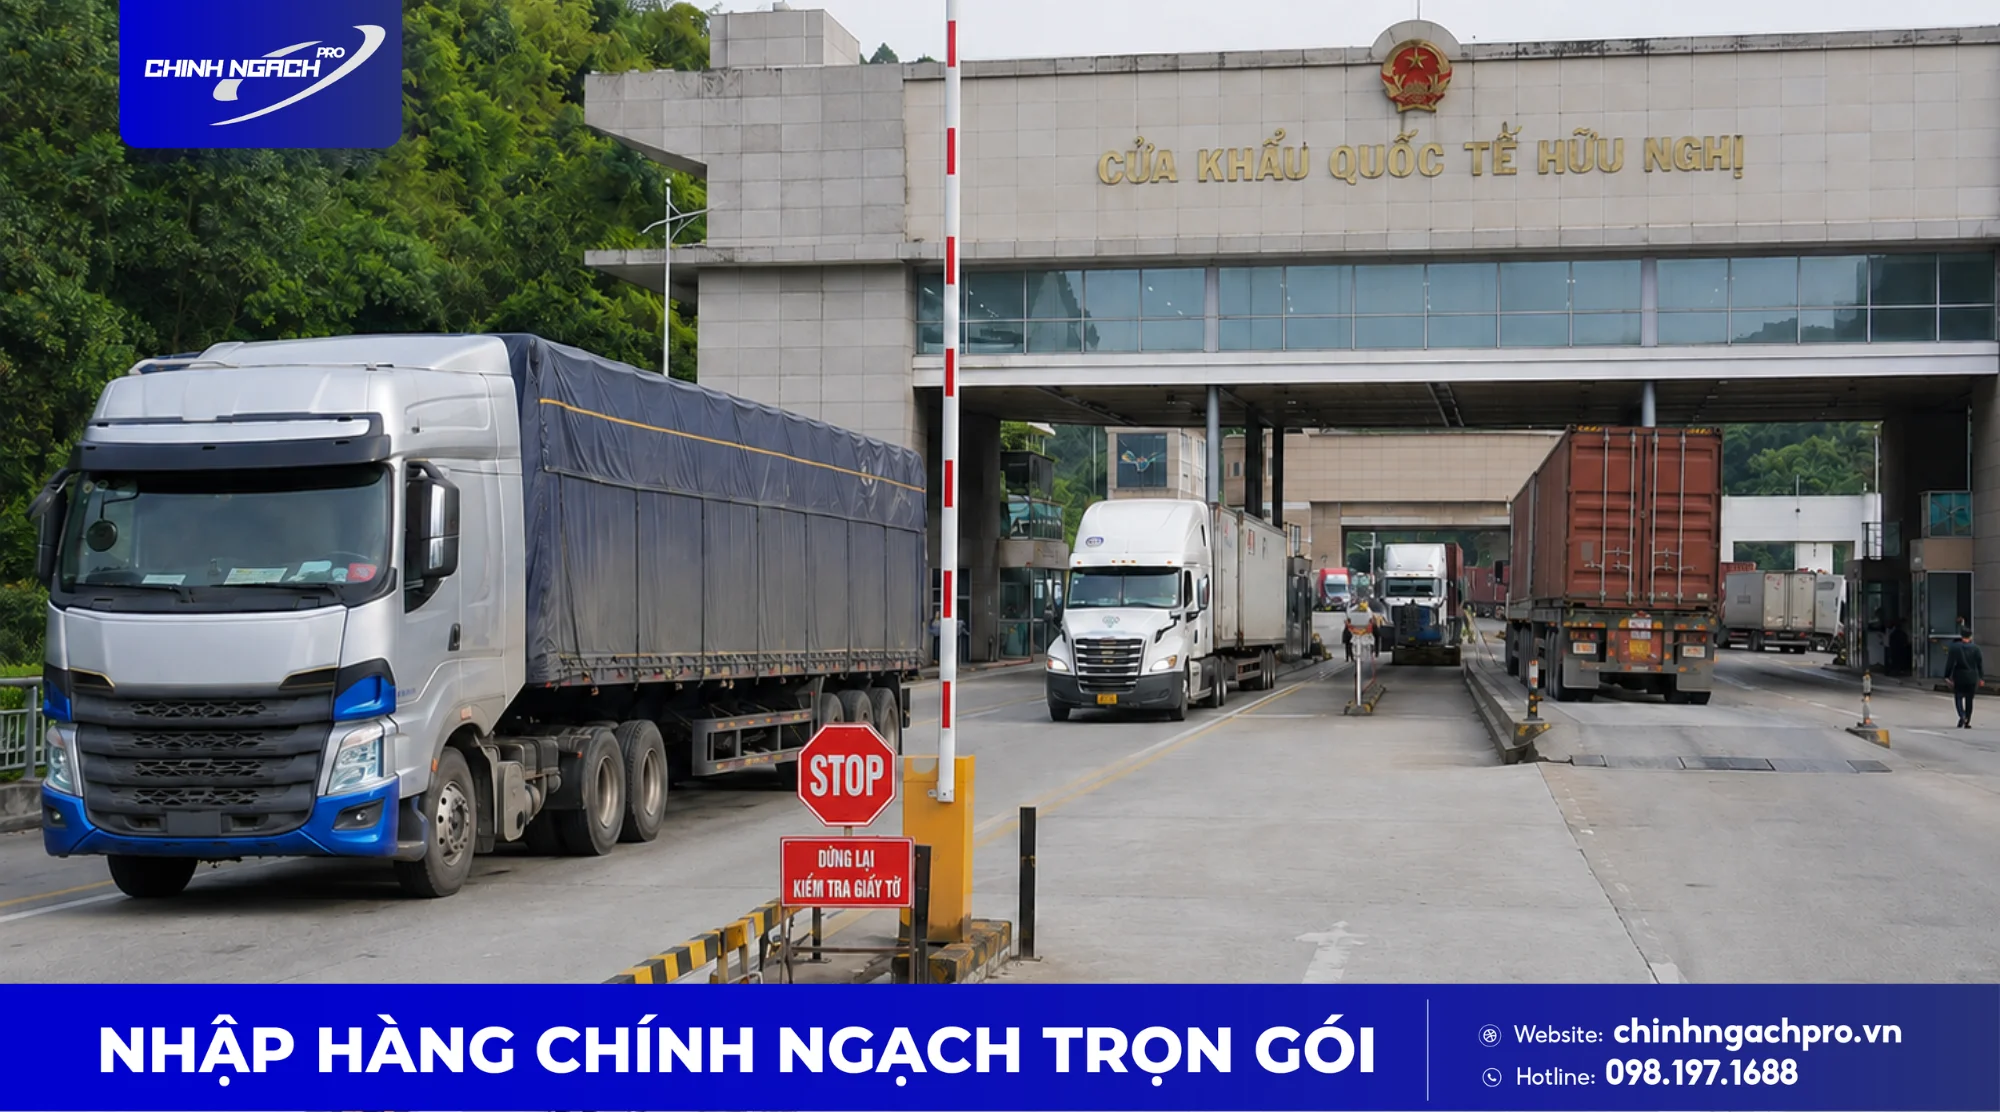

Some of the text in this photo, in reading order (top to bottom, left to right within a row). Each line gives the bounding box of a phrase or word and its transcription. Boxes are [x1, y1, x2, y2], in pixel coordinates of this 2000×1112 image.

[1097, 124, 1744, 185] CỬA KHẨU QUỐC TẾ HỮU NGHỊ
[810, 754, 884, 797] STOP
[818, 845, 875, 872] DỪNG LẠI
[827, 879, 851, 898] TRA
[854, 874, 882, 898] GIẤY
[884, 875, 901, 898] TỜ
